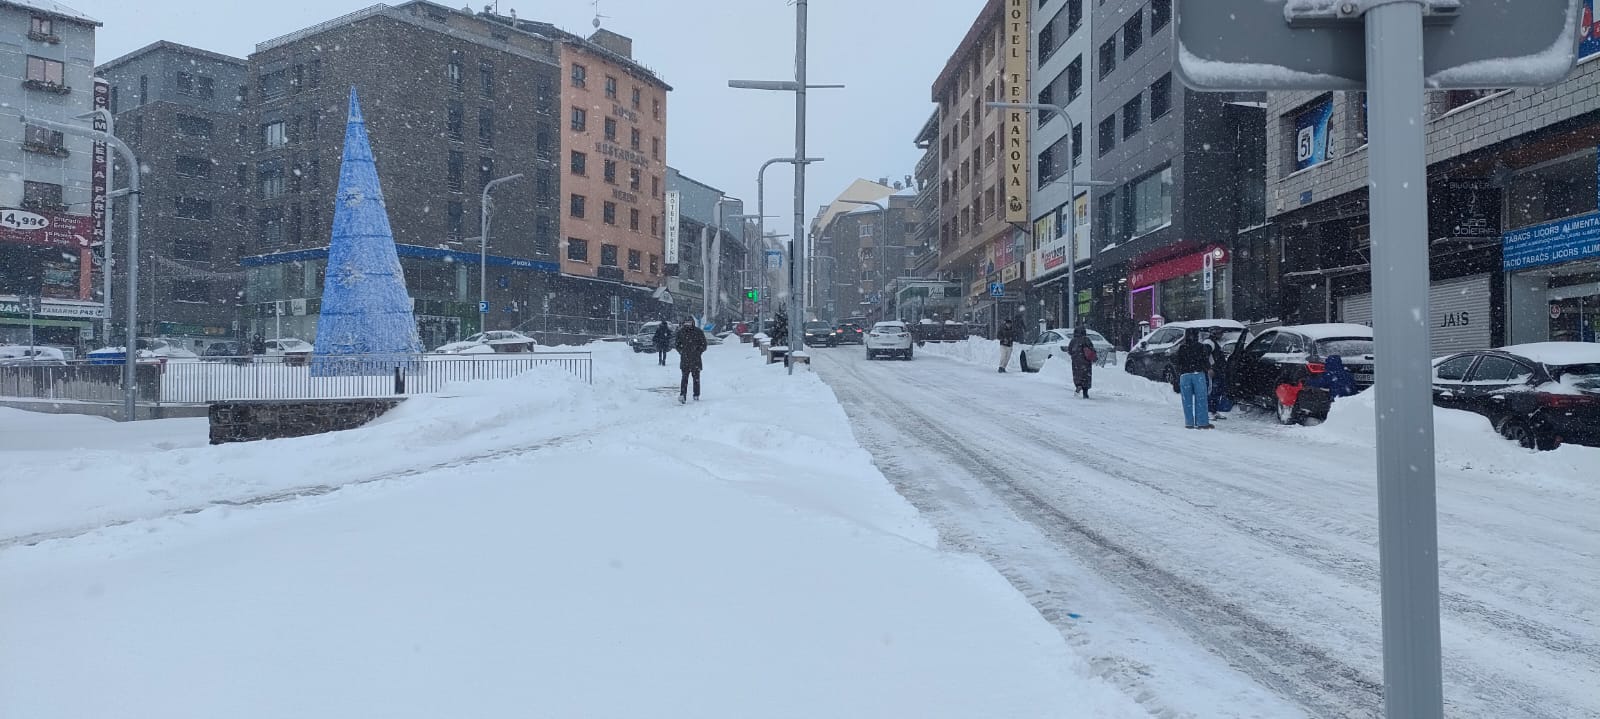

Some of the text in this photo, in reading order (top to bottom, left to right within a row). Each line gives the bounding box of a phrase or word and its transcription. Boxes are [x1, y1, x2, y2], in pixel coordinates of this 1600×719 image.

[1011, 0, 1021, 57] HOTEL
[1301, 135, 1311, 158] 51
[1505, 231, 1531, 244] TABACS
[1534, 226, 1559, 238] LICORS
[1522, 252, 1549, 265] TABACS
[1552, 247, 1578, 260] LICORS
